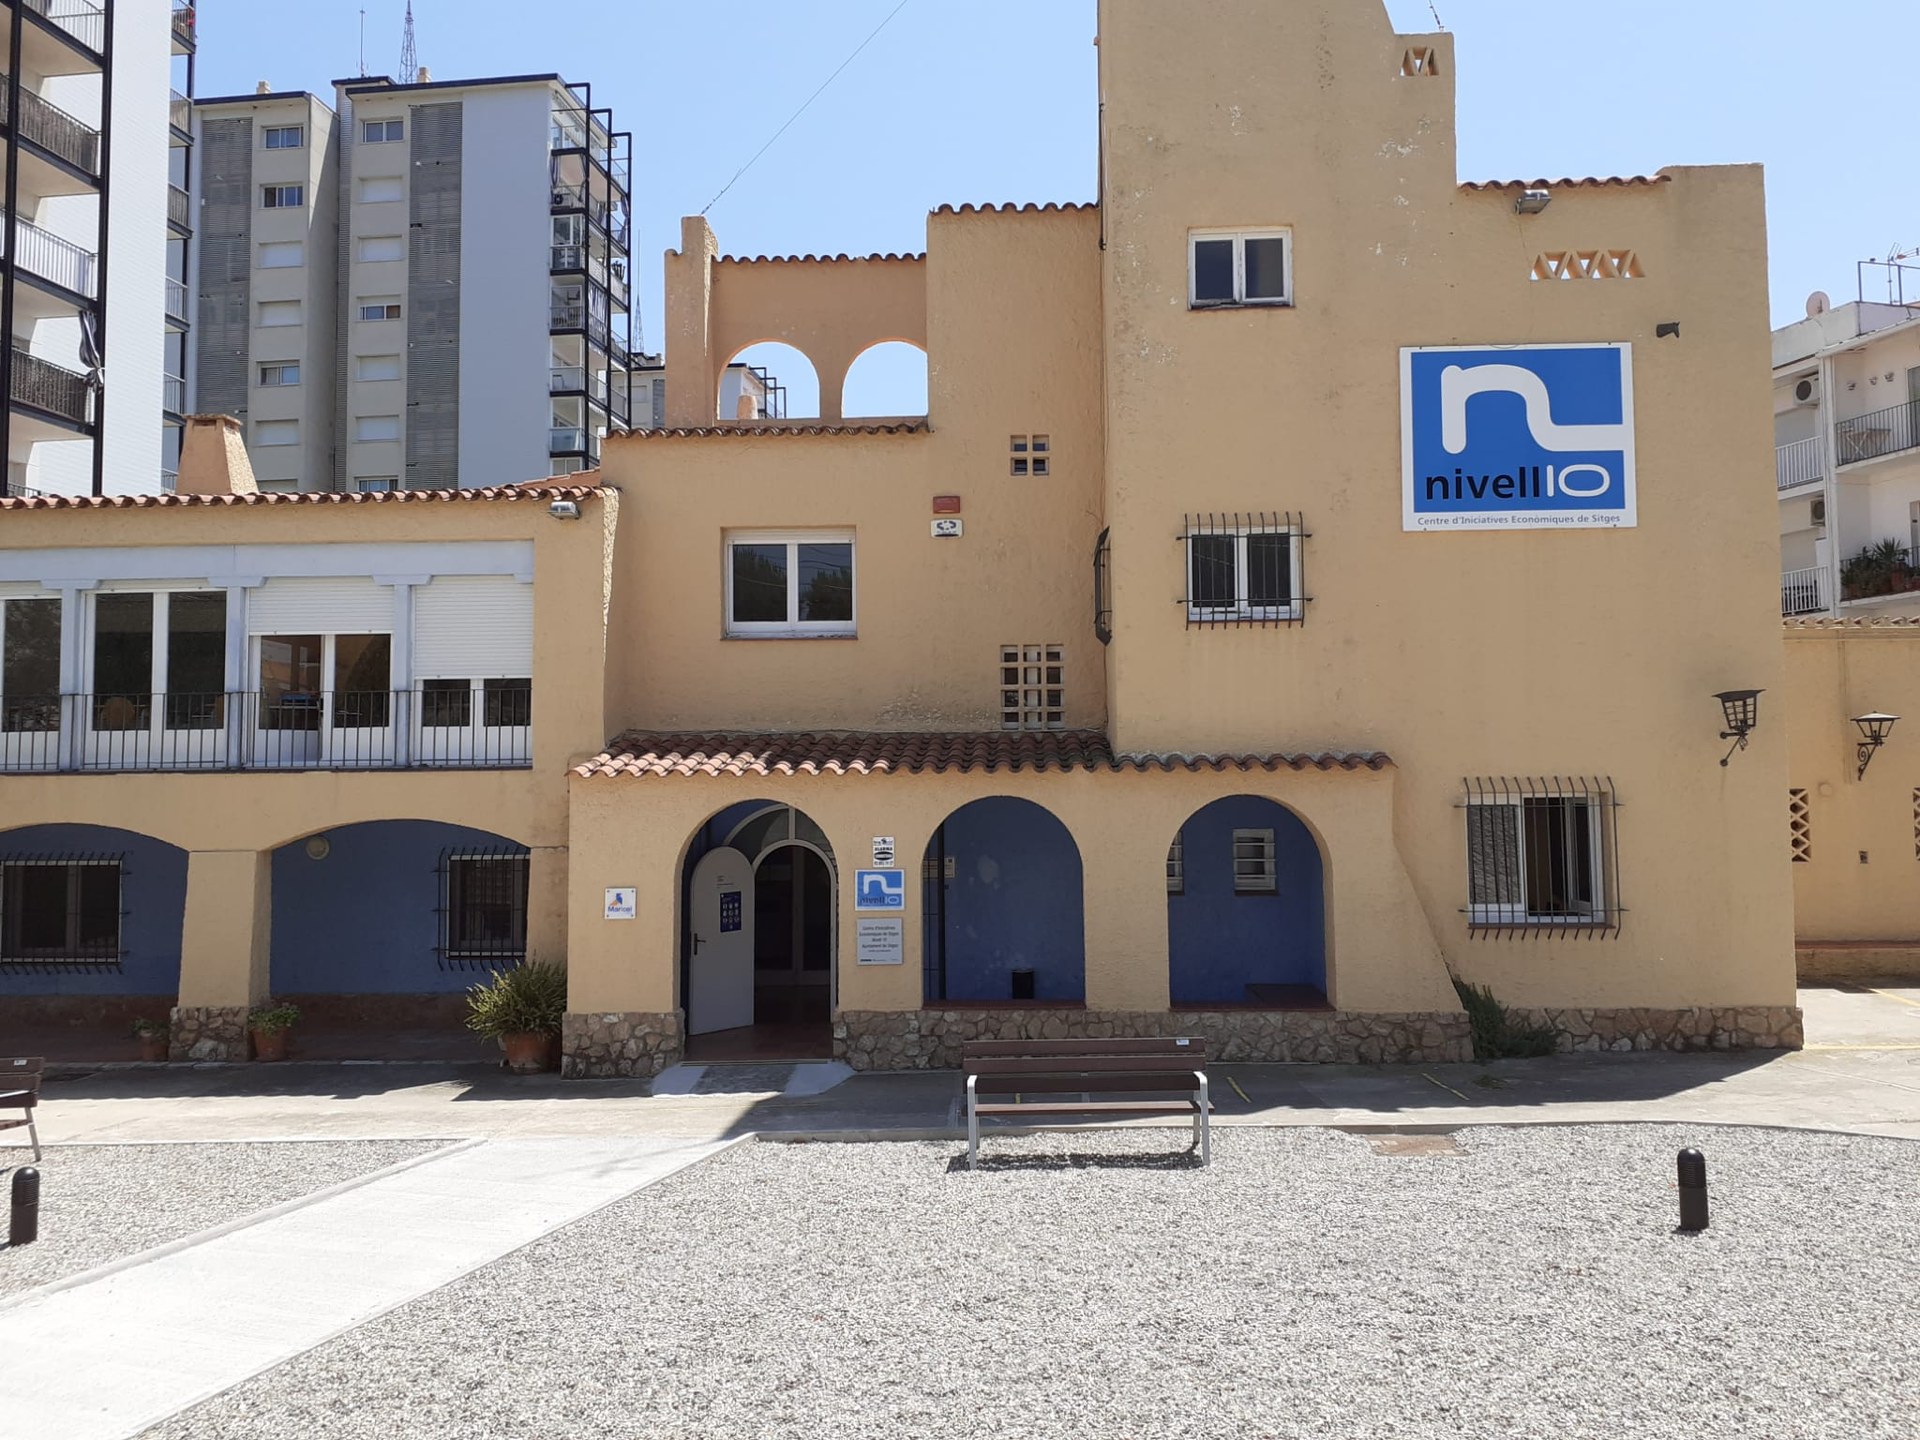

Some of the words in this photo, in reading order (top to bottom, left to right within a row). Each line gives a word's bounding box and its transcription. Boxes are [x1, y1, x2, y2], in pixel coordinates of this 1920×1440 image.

[1417, 516, 1449, 526] Centre
[1452, 515, 1509, 525] d'Iniciatives
[1577, 514, 1589, 523] de
[1592, 513, 1621, 524] Sitges
